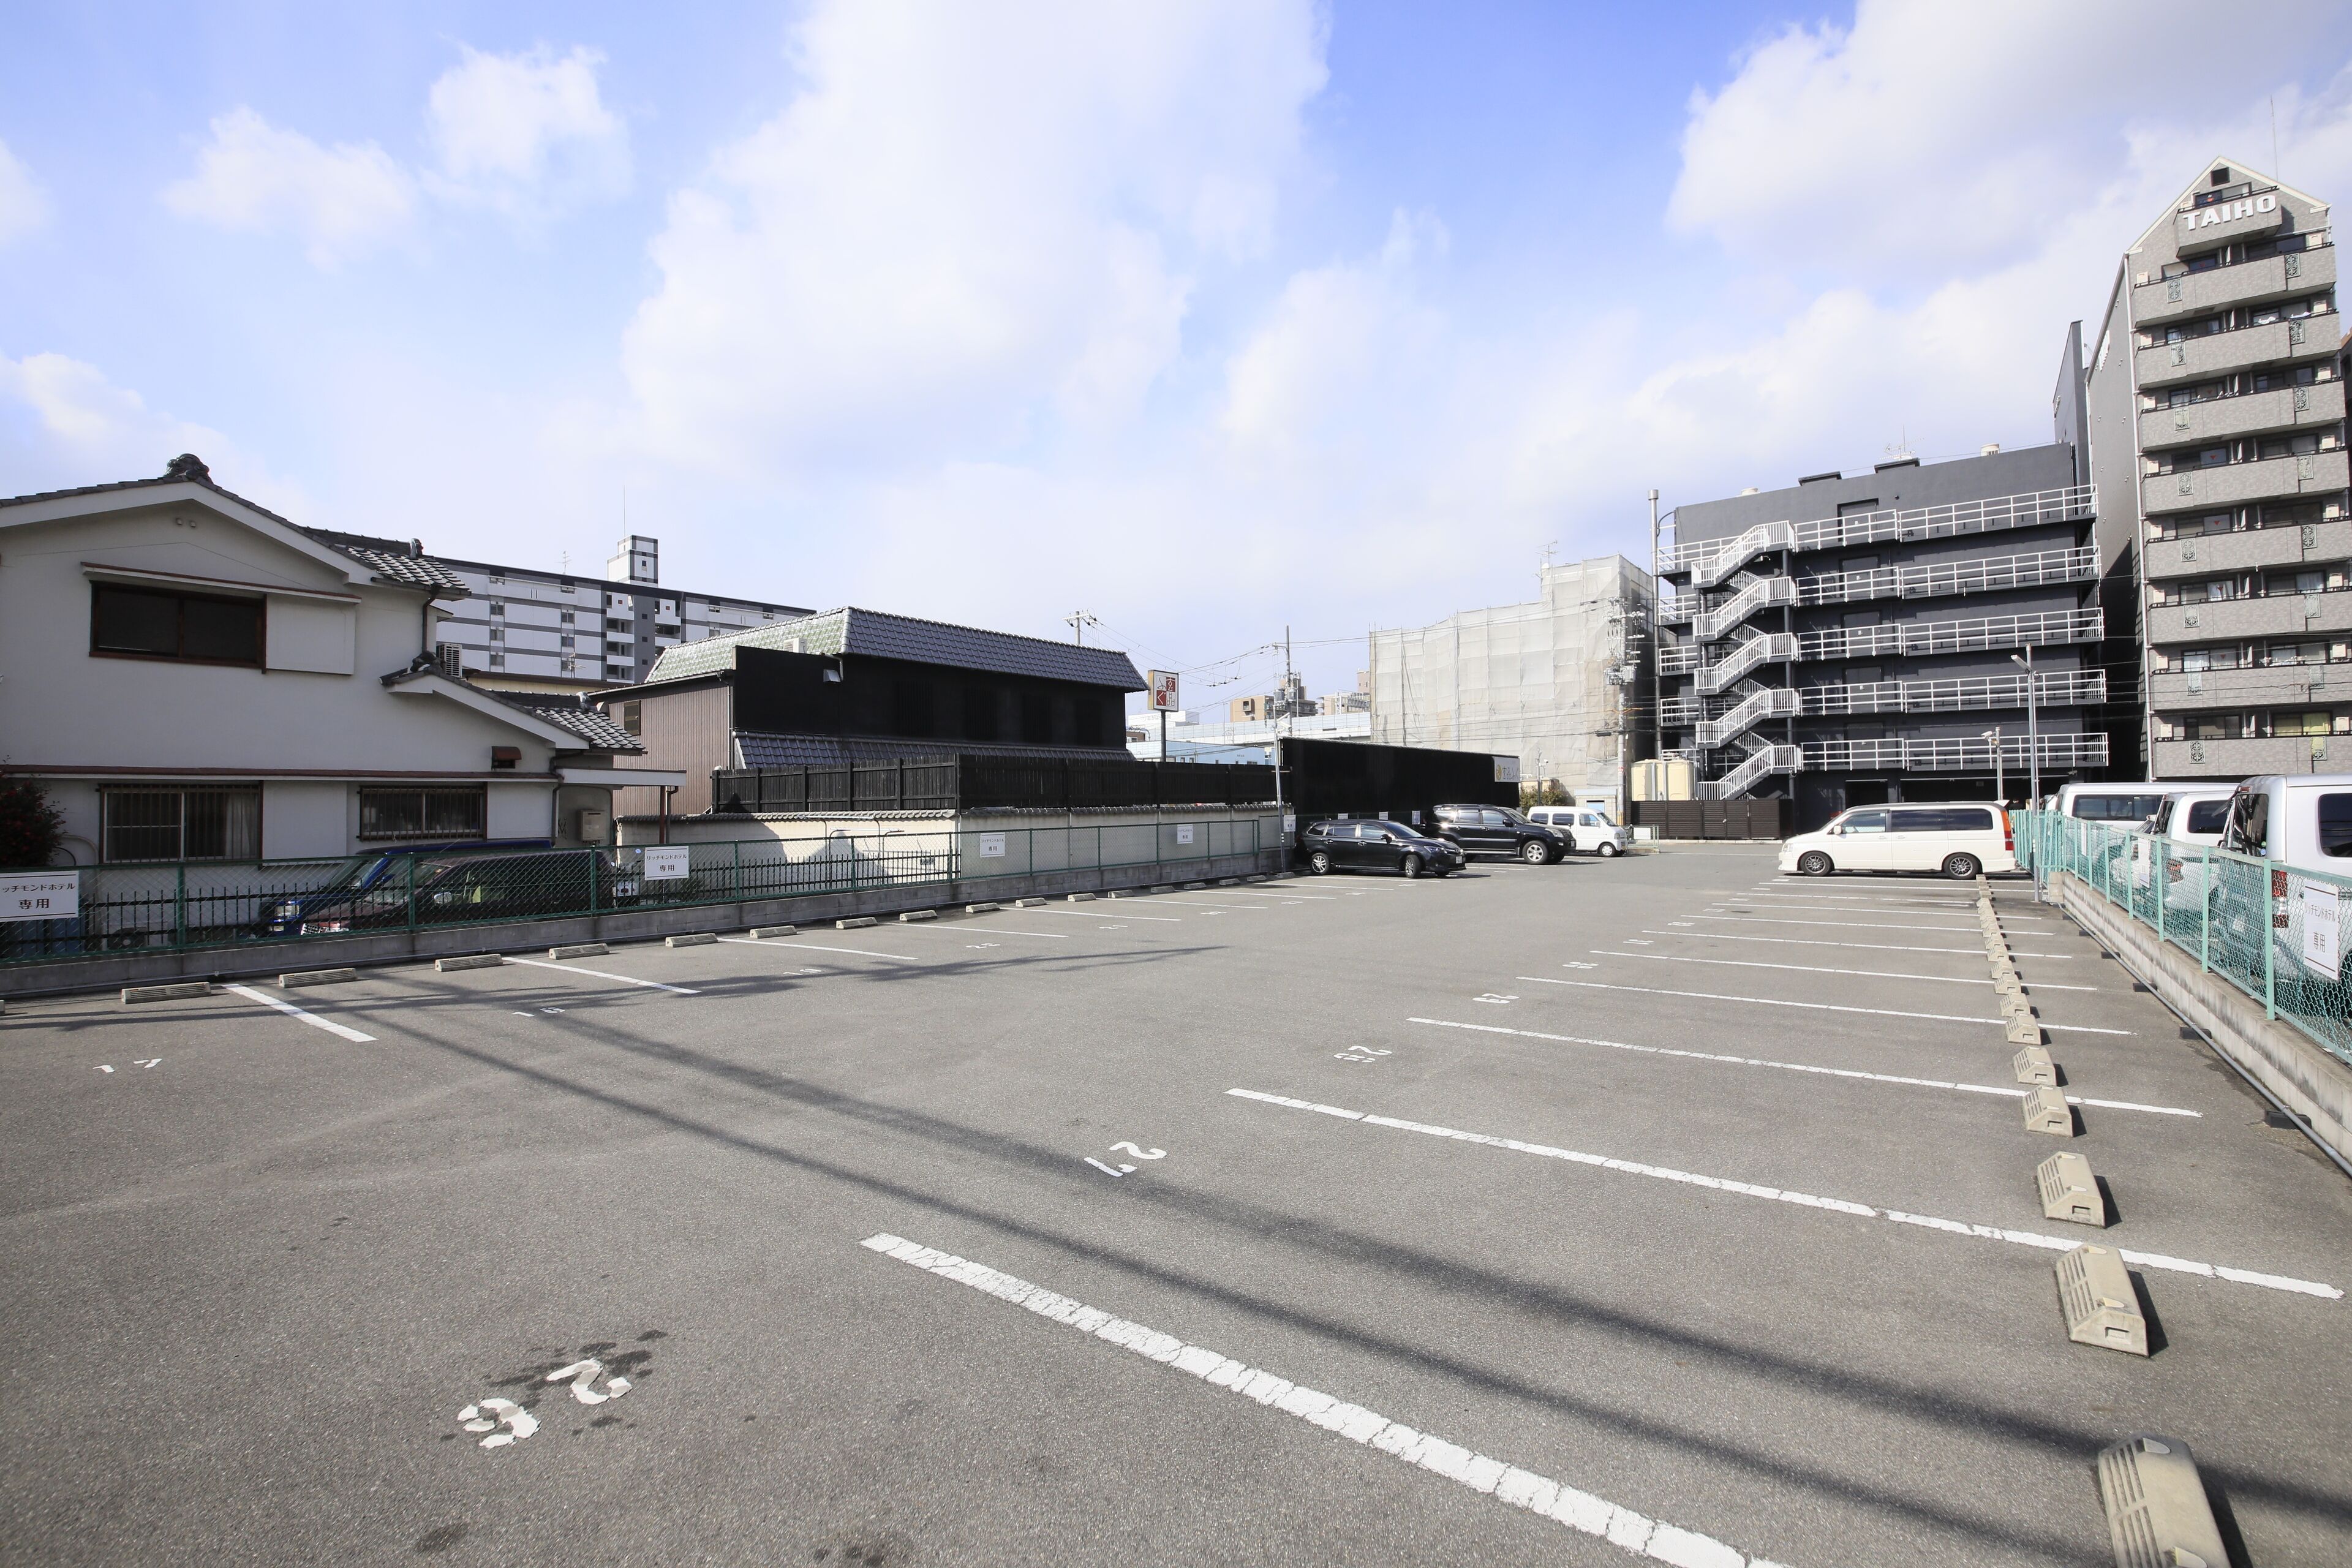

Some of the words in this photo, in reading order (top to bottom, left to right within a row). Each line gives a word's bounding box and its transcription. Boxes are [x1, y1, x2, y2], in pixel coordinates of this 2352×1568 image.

[2182, 195, 2276, 230] TAIHO
[18, 899, 50, 910] 専用
[2304, 902, 2335, 922] リッチモンドホテル
[2313, 931, 2326, 953] 専用
[93, 1058, 162, 1073] 17
[1084, 1141, 1167, 1177] 27
[457, 1357, 632, 1450] 26
